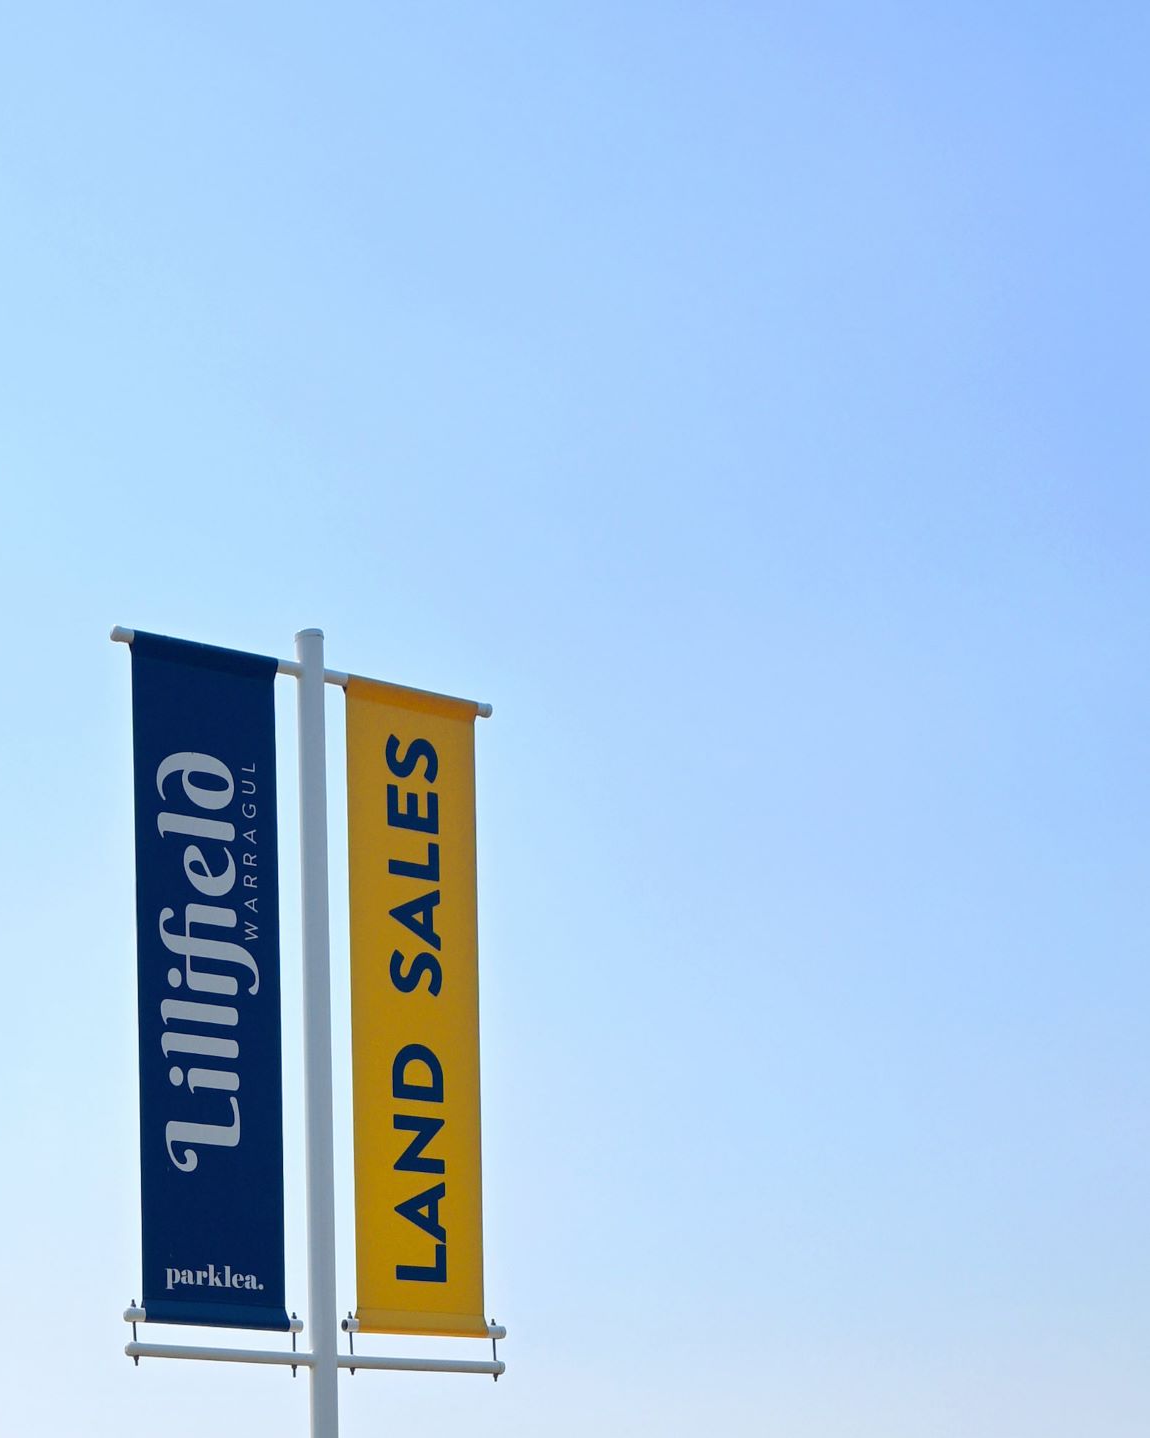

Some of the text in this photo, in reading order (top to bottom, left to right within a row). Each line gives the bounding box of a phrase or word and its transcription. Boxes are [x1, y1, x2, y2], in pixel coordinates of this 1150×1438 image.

[156, 751, 260, 1173] Lillifield
[241, 762, 260, 941] WARRAGUL
[384, 733, 448, 1284] LAND SALES
[166, 1264, 264, 1290] parklea.
